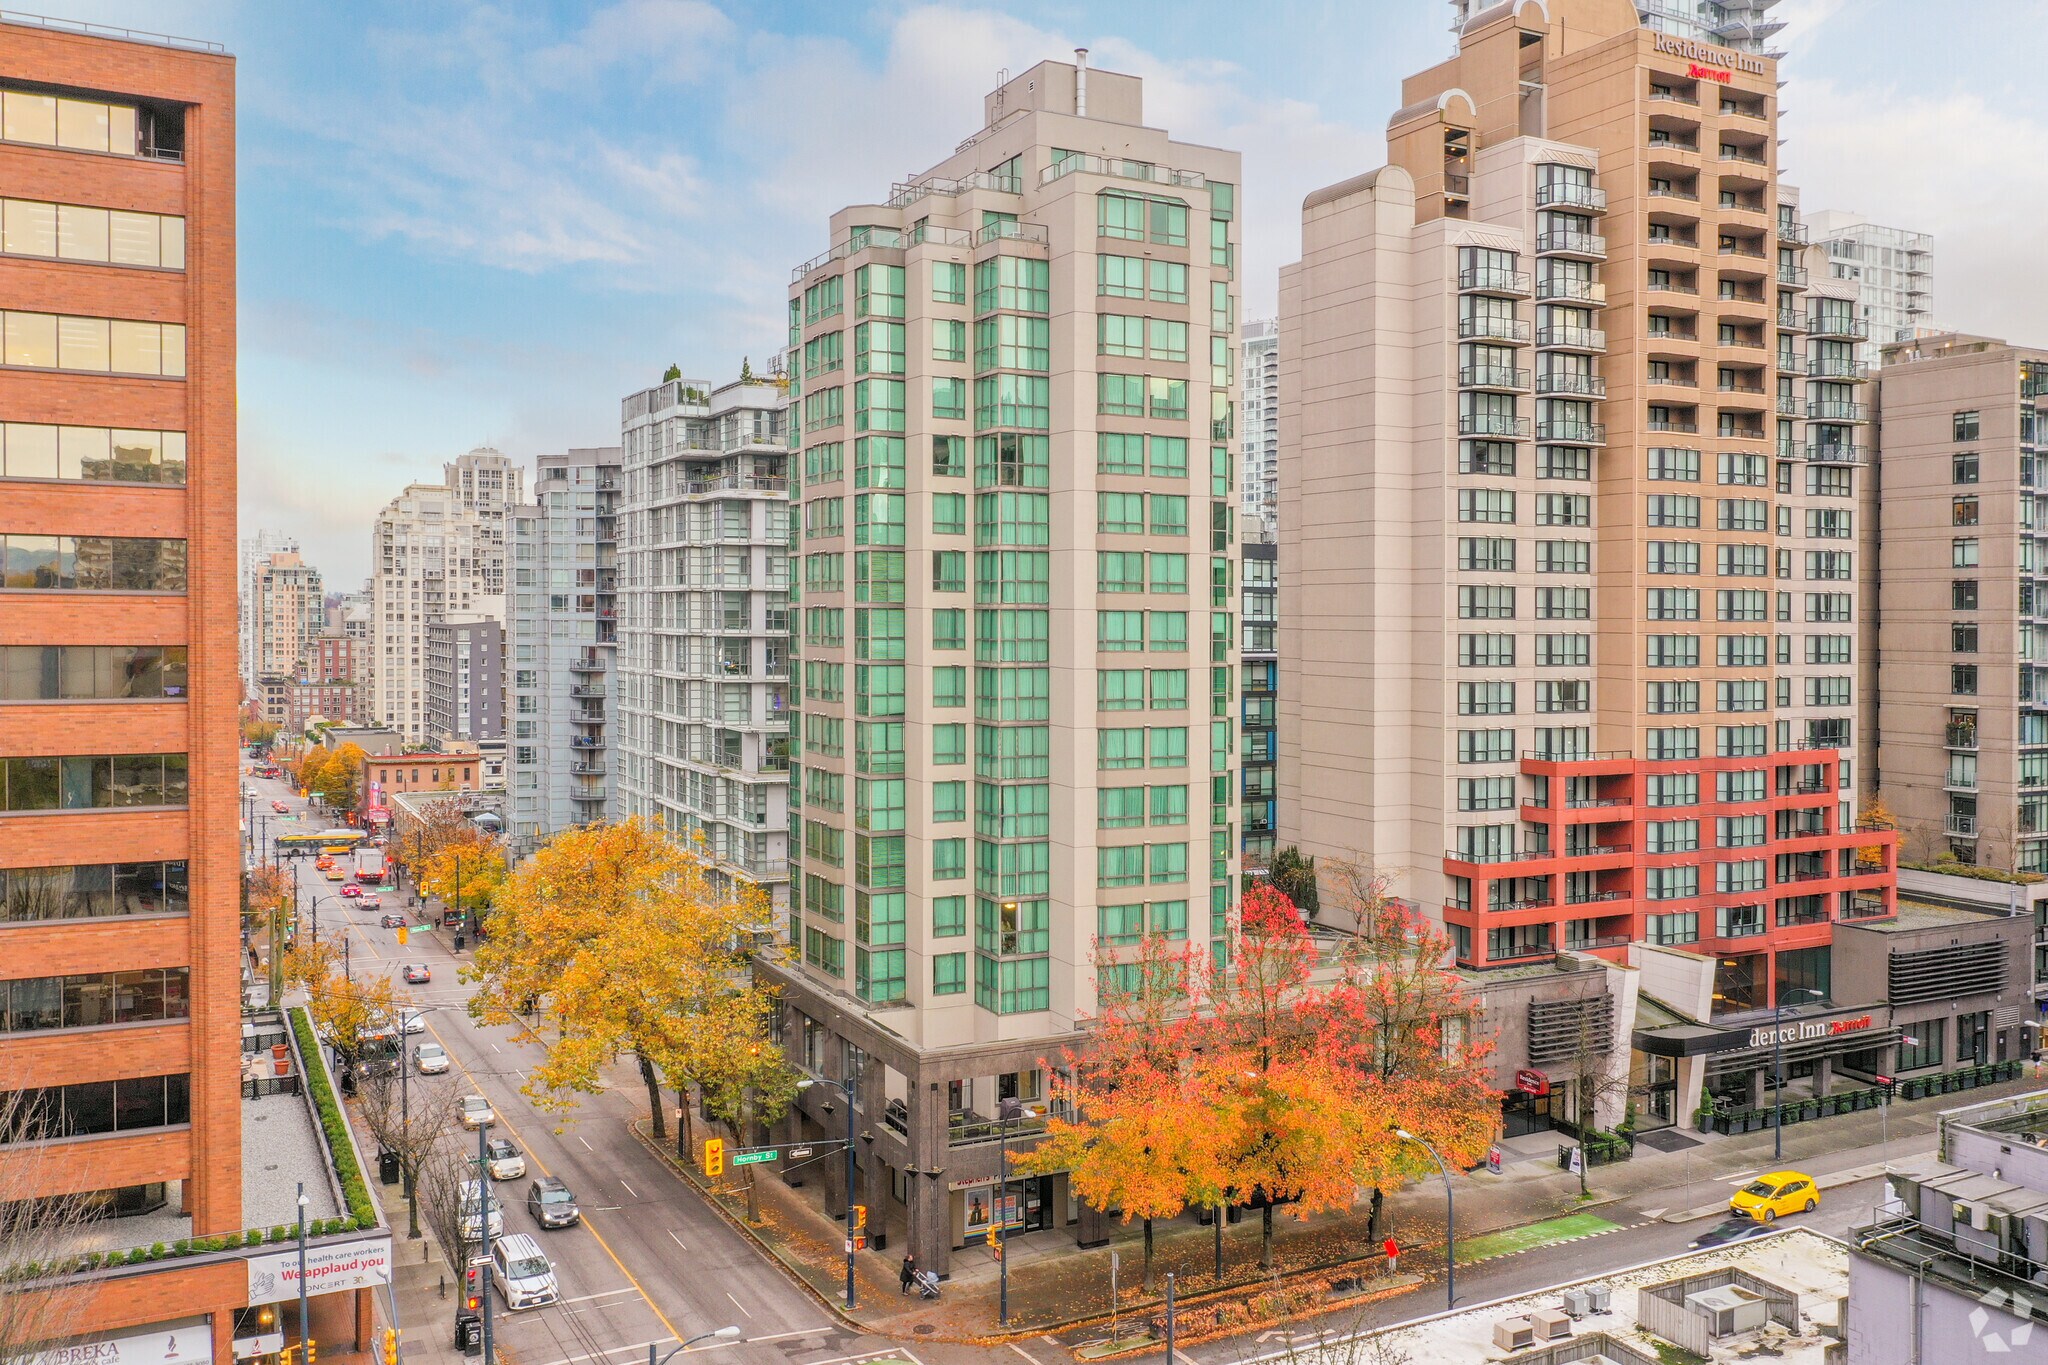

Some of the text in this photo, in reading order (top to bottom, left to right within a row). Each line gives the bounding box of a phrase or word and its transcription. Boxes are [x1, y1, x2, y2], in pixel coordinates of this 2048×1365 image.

[1653, 32, 1764, 75] Residence Inn
[1798, 1021, 1826, 1040] Inn
[737, 1154, 762, 1163] Hornby
[292, 1260, 304, 1268] ou
[307, 1253, 334, 1264] health
[335, 1251, 352, 1260] care
[353, 1246, 385, 1257] workers
[281, 1257, 384, 1281] We applaud you
[57, 1342, 120, 1364] BREKA
